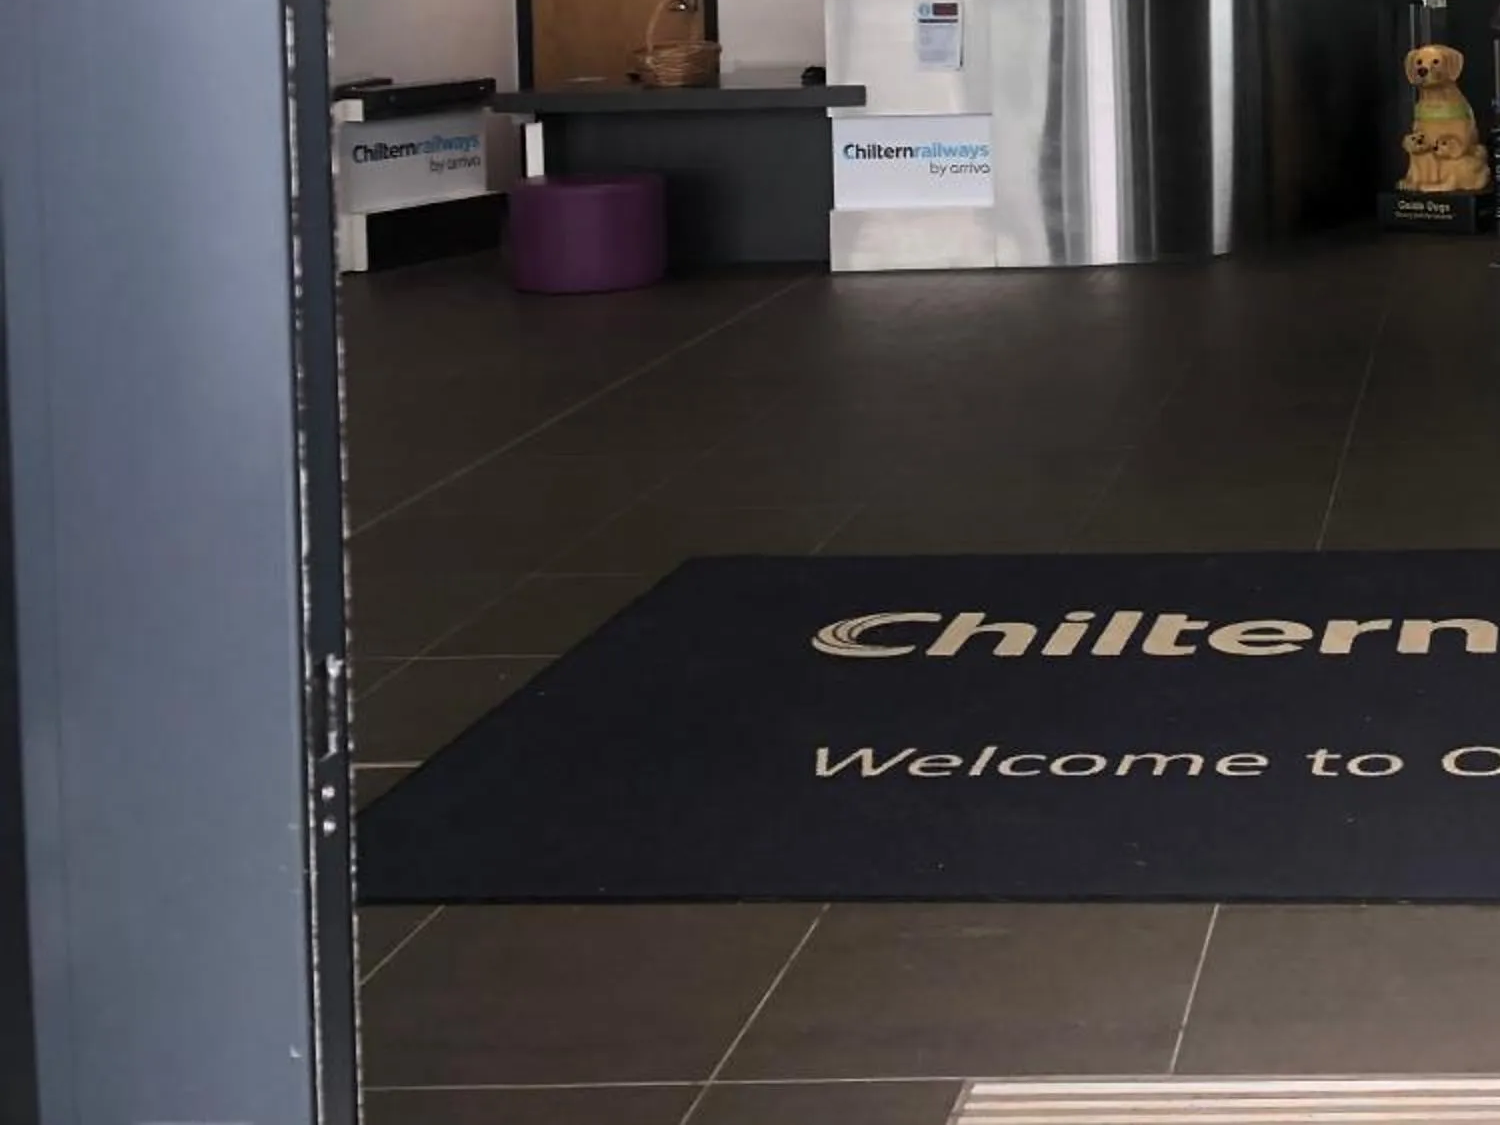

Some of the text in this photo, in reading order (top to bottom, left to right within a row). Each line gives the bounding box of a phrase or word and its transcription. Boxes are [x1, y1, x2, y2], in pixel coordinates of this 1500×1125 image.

[843, 142, 990, 160] Chilternrailways
[430, 156, 481, 174] by arriva
[929, 162, 991, 178] by arriva
[814, 746, 1270, 777] Welcome
[1305, 748, 1404, 777] to
